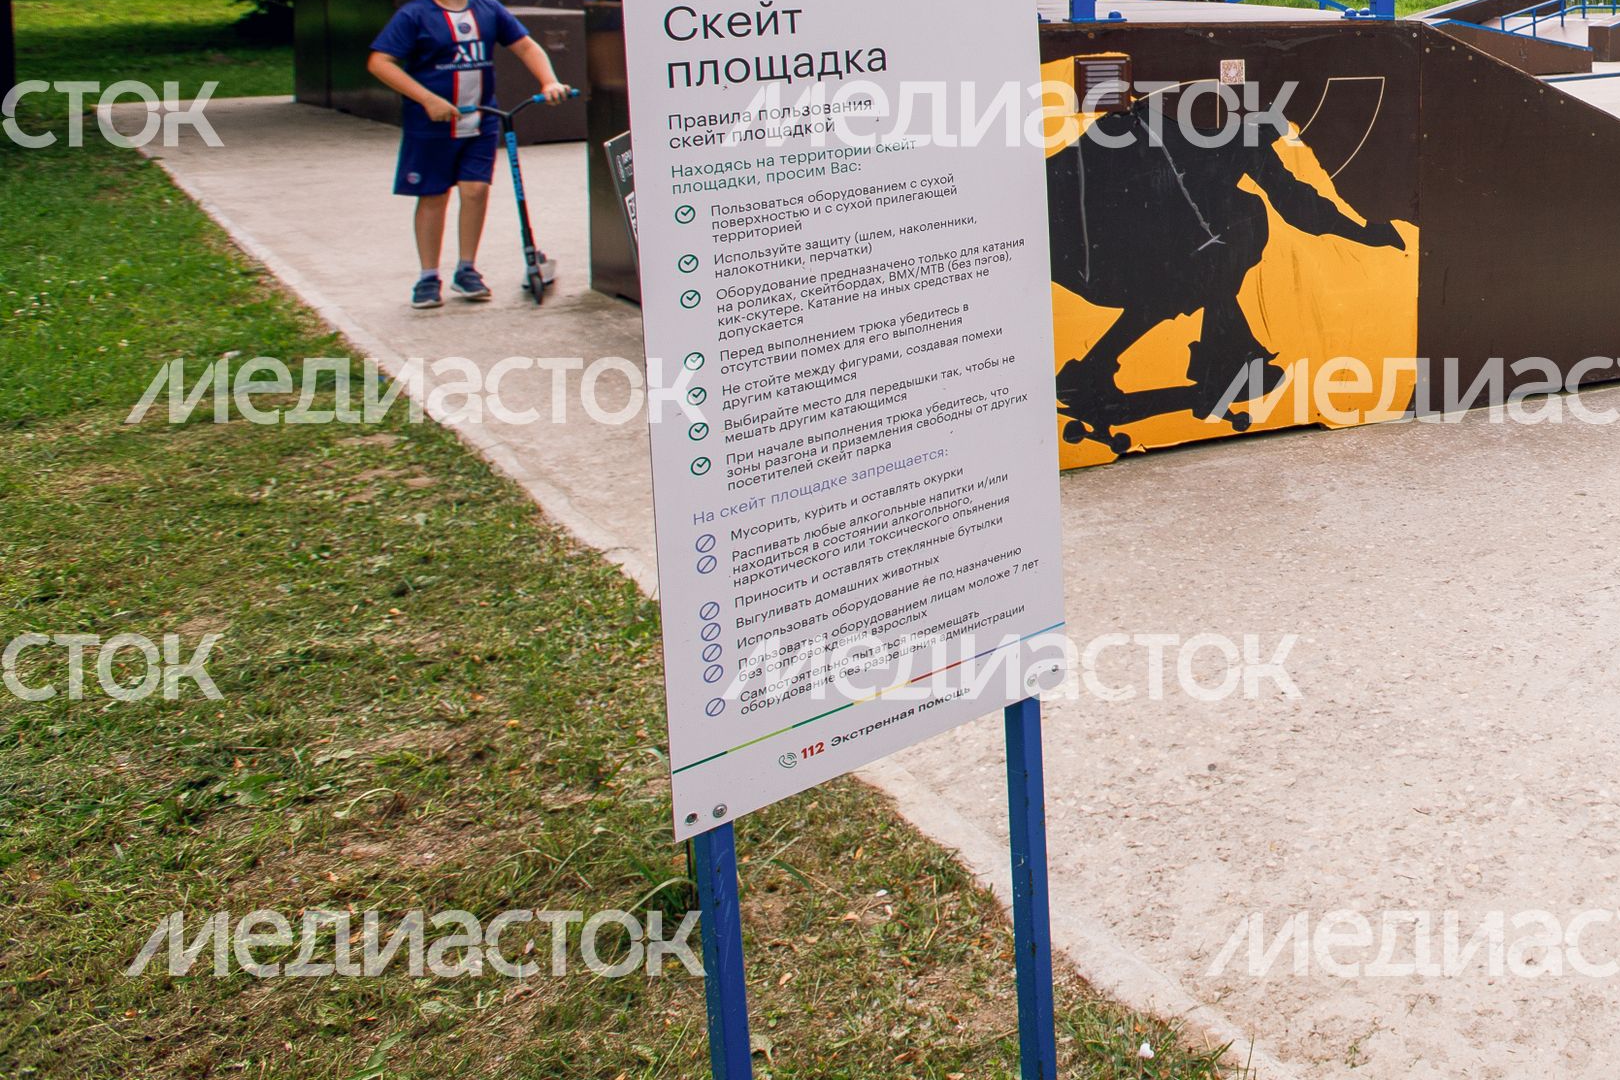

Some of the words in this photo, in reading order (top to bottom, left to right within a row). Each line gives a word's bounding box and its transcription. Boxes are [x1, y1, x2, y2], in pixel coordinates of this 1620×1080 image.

[663, 0, 803, 42] Скейт
[667, 47, 887, 91] площадка
[667, 110, 752, 133] Правила
[758, 95, 873, 124] пользования
[668, 131, 726, 150] скейт
[731, 120, 836, 143] площадкой
[671, 159, 752, 179] Находясь
[756, 156, 775, 169] на
[778, 145, 872, 166] территории
[875, 137, 917, 154] скейт
[672, 174, 761, 195] площадки,
[766, 165, 826, 185] просим
[830, 161, 862, 175] Вас:
[710, 195, 805, 217] Пользоваться
[807, 181, 907, 204] оборудованием
[909, 180, 919, 191] с
[918, 175, 954, 190] сухой
[711, 205, 810, 231] поверхностью
[813, 206, 822, 216] и
[824, 202, 834, 214] с
[833, 198, 873, 214] сухой
[875, 183, 958, 208] прилегающей
[711, 221, 803, 244] территорией
[713, 242, 802, 266] Используйте
[804, 235, 852, 251] защиту
[854, 228, 896, 245] (шлем,
[898, 215, 977, 236] наколенники,
[714, 256, 806, 279] налокотники,
[809, 240, 873, 263] перчатки)
[715, 274, 817, 301] Оборудование
[820, 257, 916, 285] предназначено
[917, 250, 958, 268] только
[959, 246, 980, 259] для
[982, 238, 1025, 256] катания
[716, 302, 734, 314] на
[737, 288, 797, 313] роликах,
[799, 275, 886, 299] скейтбордах,
[888, 262, 945, 284] BMX/MTB
[946, 258, 972, 275] (без
[974, 249, 1012, 267] пэгов),
[717, 303, 804, 328] кик-скутере.
[807, 292, 860, 311] Катание
[862, 288, 878, 300] на
[879, 283, 912, 297] иных
[912, 268, 974, 291] средствах
[975, 268, 990, 279] не
[717, 315, 804, 342] допускается
[719, 344, 765, 363] Перед
[767, 326, 856, 353] выполнением
[858, 318, 897, 335] трюка
[898, 305, 961, 328] убедитесь
[962, 303, 970, 312] в
[720, 350, 798, 375] отсутствии
[800, 341, 842, 359] помех
[843, 336, 866, 351] для
[868, 332, 890, 344] его
[892, 316, 963, 339] выполнения
[722, 383, 741, 397] Не
[744, 373, 791, 392] стойте
[794, 363, 838, 381] между
[838, 349, 903, 373] фигурами,
[905, 336, 959, 356] создавая
[961, 327, 1003, 344] помехи
[722, 390, 773, 412] другим
[775, 371, 857, 398] катающимся
[724, 405, 800, 434] Выбирайте
[802, 395, 842, 413] место
[844, 389, 867, 405] для
[869, 373, 938, 397] передышки
[940, 368, 963, 380] так,
[964, 357, 1000, 373] чтобы
[1001, 354, 1016, 365] не
[724, 424, 777, 444] мешать
[778, 411, 827, 433] другим
[829, 392, 908, 419] катающимся
[725, 450, 754, 466] При
[757, 438, 805, 458] начале
[807, 418, 884, 445] выполнения
[885, 408, 925, 426] трюка
[925, 393, 988, 417] убедитесь,
[989, 386, 1010, 398] что
[726, 461, 761, 479] зоны
[764, 447, 818, 471] разгона
[820, 444, 829, 454] и
[831, 422, 913, 454] приземления
[915, 406, 973, 429] свободны
[975, 403, 989, 414] от
[990, 393, 1028, 412] других
[693, 511, 715, 526] На
[719, 496, 767, 518] скейт
[770, 475, 848, 505] площадке
[851, 448, 949, 482] запрещается:
[727, 458, 814, 492] посетителей
[816, 450, 854, 468] скейт
[855, 440, 892, 457] парка
[730, 515, 801, 542] Мусорить,
[804, 501, 848, 521] курить
[850, 497, 858, 507] и
[860, 480, 921, 504] оставлять
[922, 467, 964, 486] окурки
[731, 535, 801, 563] Распивать
[802, 521, 847, 542] любые
[849, 497, 927, 528] алкогольные
[928, 483, 975, 504] напитки
[977, 473, 1009, 489] и/или
[732, 544, 810, 575] находиться
[812, 541, 820, 551] в
[822, 520, 889, 548] состоянии
[891, 496, 973, 528] алкогольного,
[733, 547, 841, 588] наркотического
[843, 539, 866, 554] или
[868, 514, 950, 546] токсического
[952, 495, 1010, 520] опьянения
[734, 578, 808, 609] Приносить
[811, 574, 819, 584] и
[821, 554, 884, 580] оставлять
[886, 531, 955, 560] стеклянные
[957, 516, 1004, 537] бутылки
[735, 598, 812, 630] Выгуливать
[814, 575, 879, 605] домашних
[881, 555, 940, 582] животных
[736, 612, 829, 650] Использовать
[831, 581, 920, 618] оборудование
[955, 547, 1022, 576] назначению
[738, 631, 829, 671] Пользоваться
[830, 597, 928, 638] оборудованием
[929, 584, 966, 604] лицам
[968, 569, 1011, 591] моложе
[1012, 563, 1019, 575] 7
[1021, 558, 1040, 573] лет
[800, 741, 825, 760] 112
[830, 707, 915, 747] Экстренная
[918, 686, 971, 713] помощь
